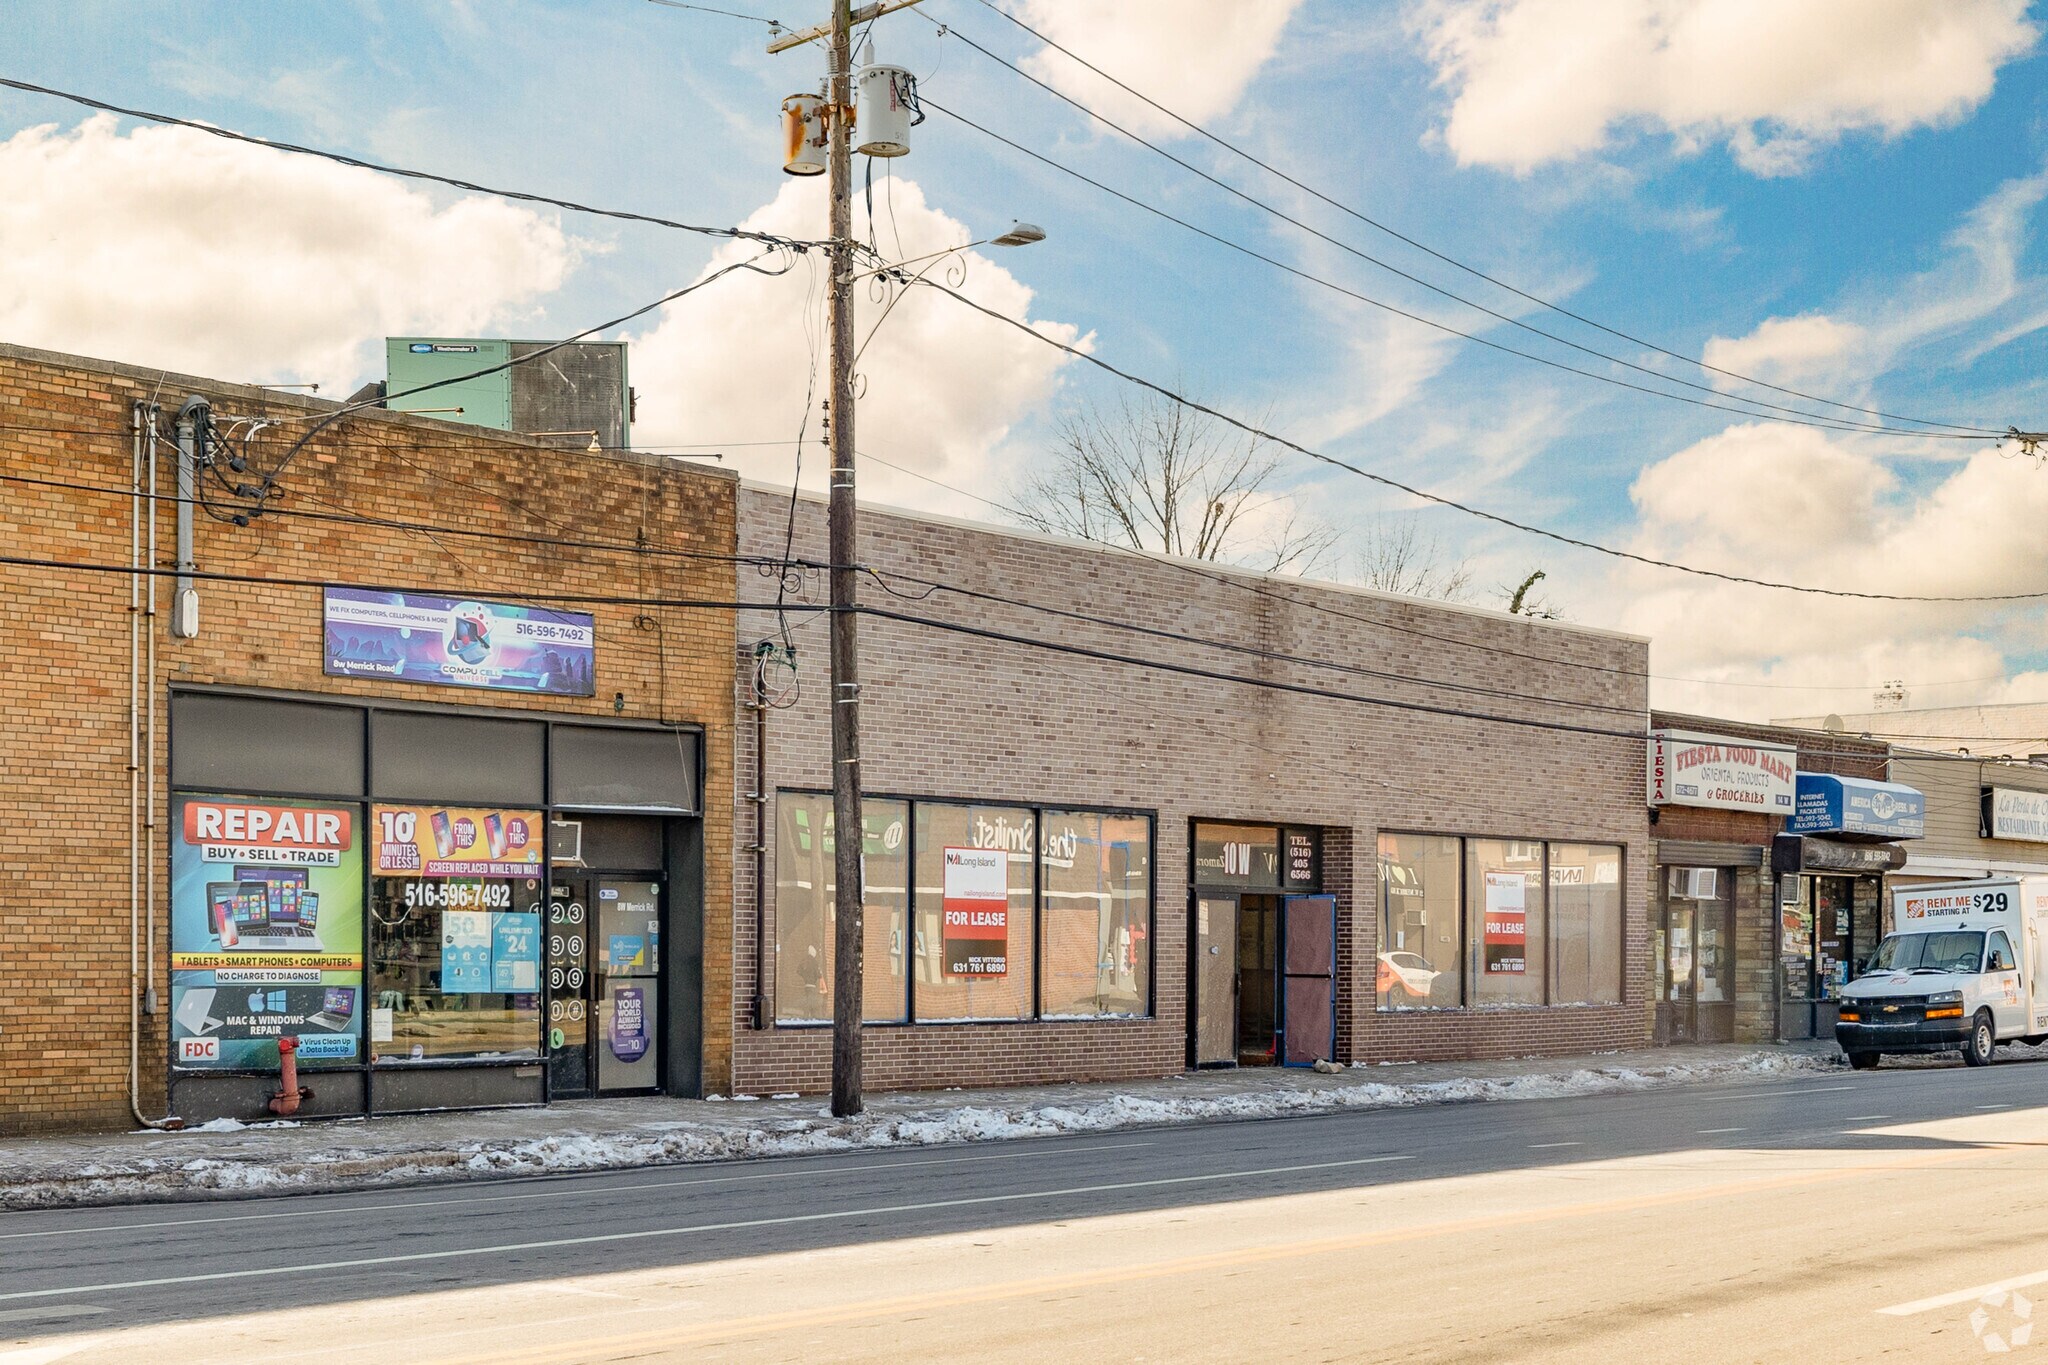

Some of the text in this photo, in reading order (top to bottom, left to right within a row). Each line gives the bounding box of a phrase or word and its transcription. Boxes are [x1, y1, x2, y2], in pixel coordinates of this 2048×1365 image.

[351, 608, 388, 618] COMPUTERS,
[389, 612, 426, 622] CELLPHONES
[516, 624, 584, 640] 516-596-7492
[346, 660, 376, 671] Merrick
[376, 663, 396, 673] Road
[442, 666, 500, 677] COMPU CELL
[454, 674, 488, 684] UNIVERSE
[1654, 734, 1665, 799] FIESTA
[1676, 745, 1792, 784] FIESTA FOOD MART
[1702, 767, 1769, 787] ORIENTAL PRODUCTS
[1715, 788, 1764, 804] GROCERIES
[196, 806, 340, 844] REPAIR
[382, 812, 416, 843] 10
[454, 823, 474, 835] FROM
[512, 822, 521, 832] TO
[1998, 817, 2040, 835] RESTAURANTE
[456, 835, 473, 846] THIS
[509, 832, 525, 844] THIS
[1290, 836, 1311, 846] TEL.
[208, 848, 334, 862] BUY SELL TRADE
[382, 844, 418, 856] MINUTES
[1290, 847, 1311, 858] (516)
[380, 856, 391, 868] OR
[960, 858, 976, 868] Long
[977, 858, 996, 867] Island
[1223, 842, 1250, 875] 10 W
[429, 862, 538, 874] SCREEN REPLACED WHILE YOU WAIT
[405, 883, 510, 907] 516-596-7492
[617, 902, 655, 911] 8W Merrick Rd.
[1927, 893, 2008, 912] RENT ME $29
[552, 907, 579, 920] 2 3
[946, 911, 1005, 926] FOR LEASE
[1927, 908, 1960, 917] STARTING
[1487, 923, 1524, 933] FOR LEASE
[552, 940, 579, 952] 5 6
[180, 957, 352, 967] TABLETS SMART PHONES COMPUTERS
[953, 963, 1005, 972] 631 761 6890
[217, 972, 318, 981] NO CHARGE TO DIAGNOSE
[552, 972, 579, 984] 8 9
[617, 1000, 641, 1009] YOUR
[227, 1016, 304, 1025] MAC & WINDOWS
[250, 1026, 281, 1034] REPAIR
[341, 1038, 351, 1046] Up
[186, 1042, 214, 1056] FDC
[340, 1046, 349, 1054] Up
